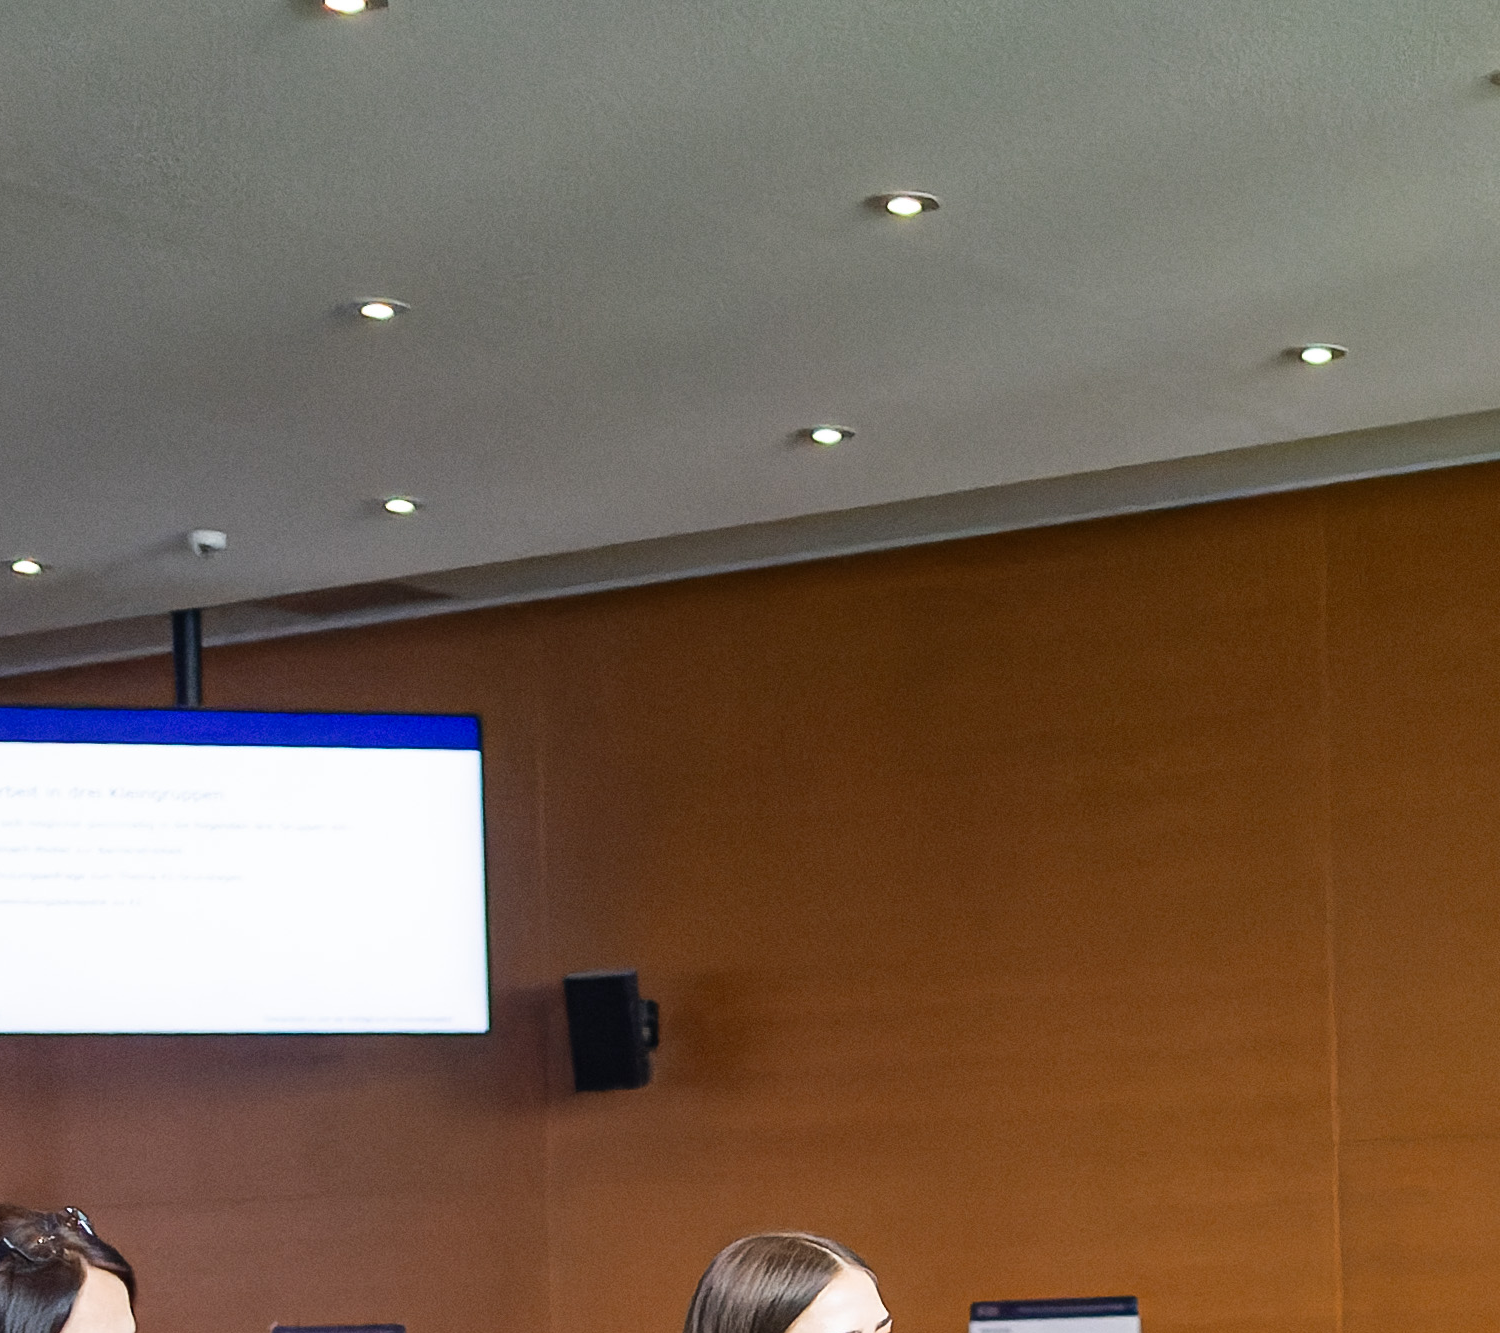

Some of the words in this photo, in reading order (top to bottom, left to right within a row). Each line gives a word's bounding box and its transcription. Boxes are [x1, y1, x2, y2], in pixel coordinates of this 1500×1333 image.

[46, 784, 62, 798] in
[67, 784, 101, 799] drei
[109, 786, 224, 804] Kleingruppen
